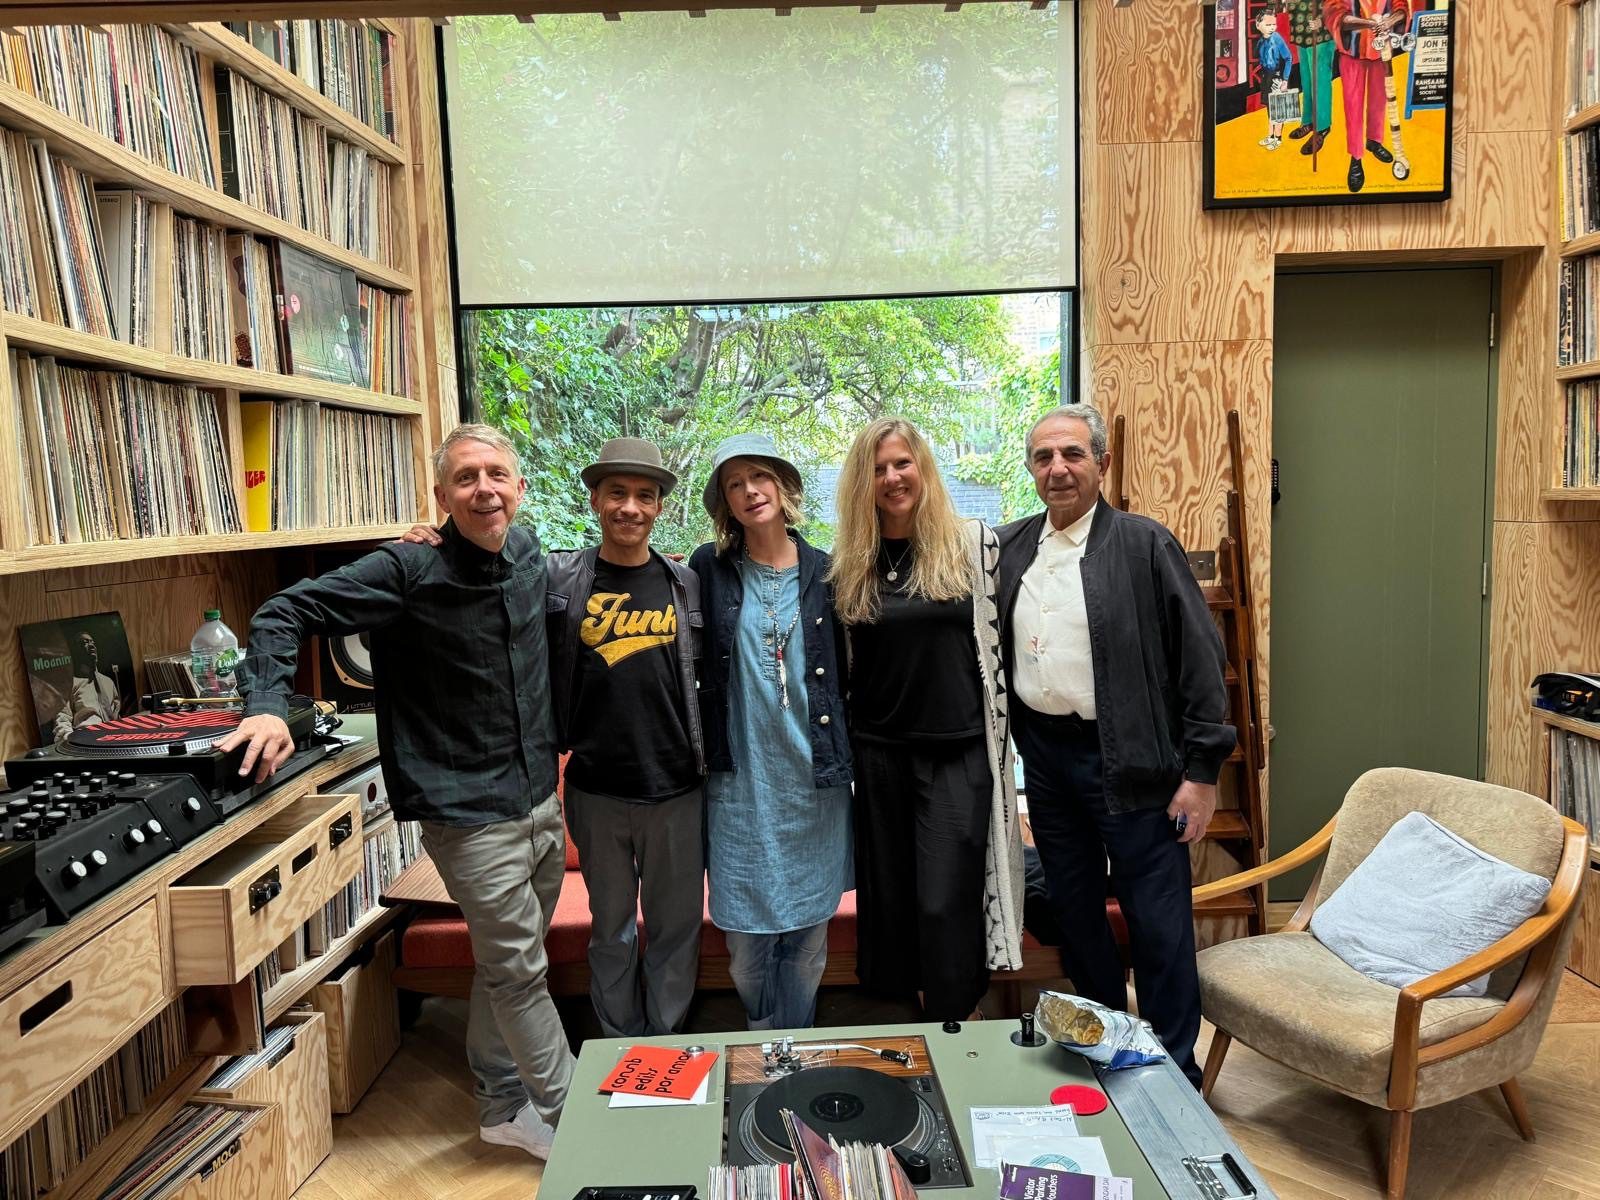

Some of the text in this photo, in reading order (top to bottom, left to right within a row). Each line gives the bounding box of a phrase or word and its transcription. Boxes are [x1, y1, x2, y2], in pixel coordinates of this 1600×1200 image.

[1422, 39, 1438, 49] JON
[580, 592, 677, 646] Funk
[1023, 1177, 1036, 1200] Visitor
[1046, 1174, 1058, 1200] ouchers
